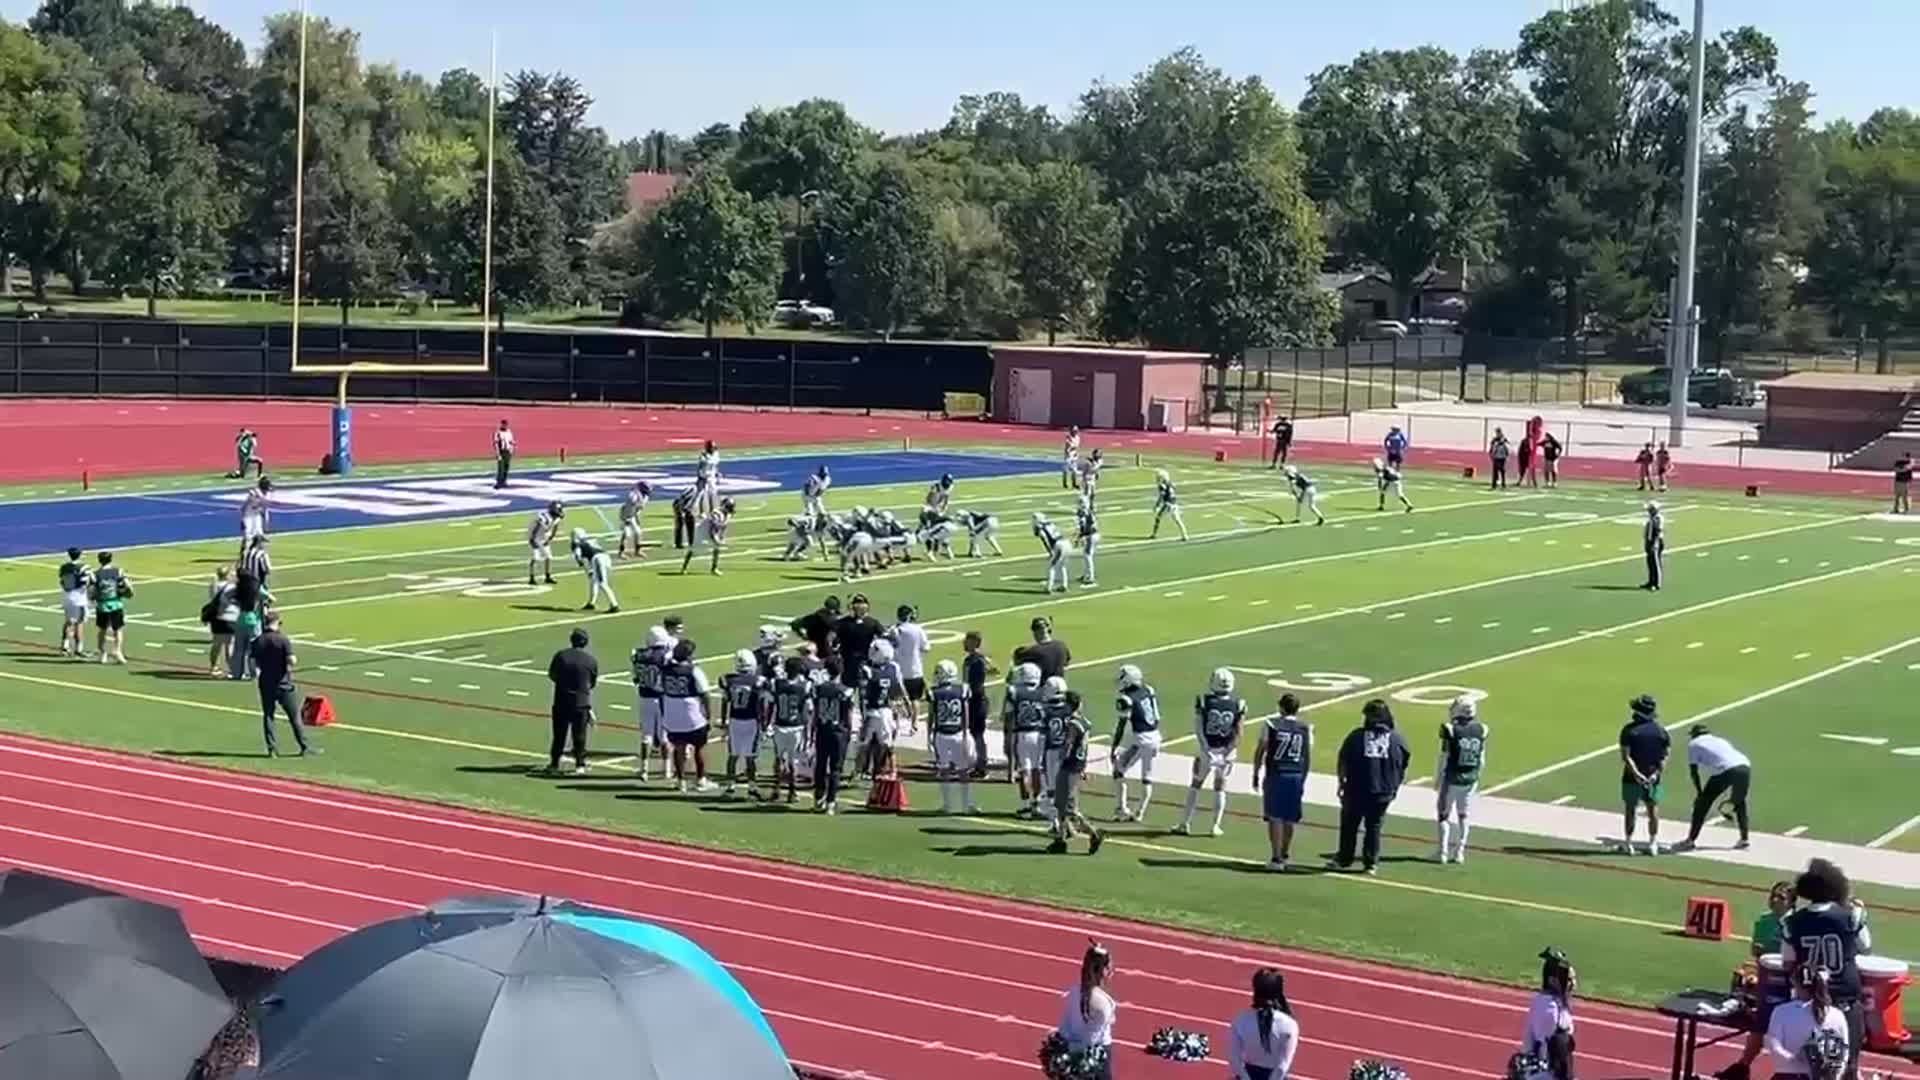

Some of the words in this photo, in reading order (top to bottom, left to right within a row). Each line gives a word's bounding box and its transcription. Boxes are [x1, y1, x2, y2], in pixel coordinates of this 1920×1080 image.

[1267, 672, 1488, 705] 30
[1689, 901, 1724, 935] 40
[1800, 932, 1844, 975] 70
